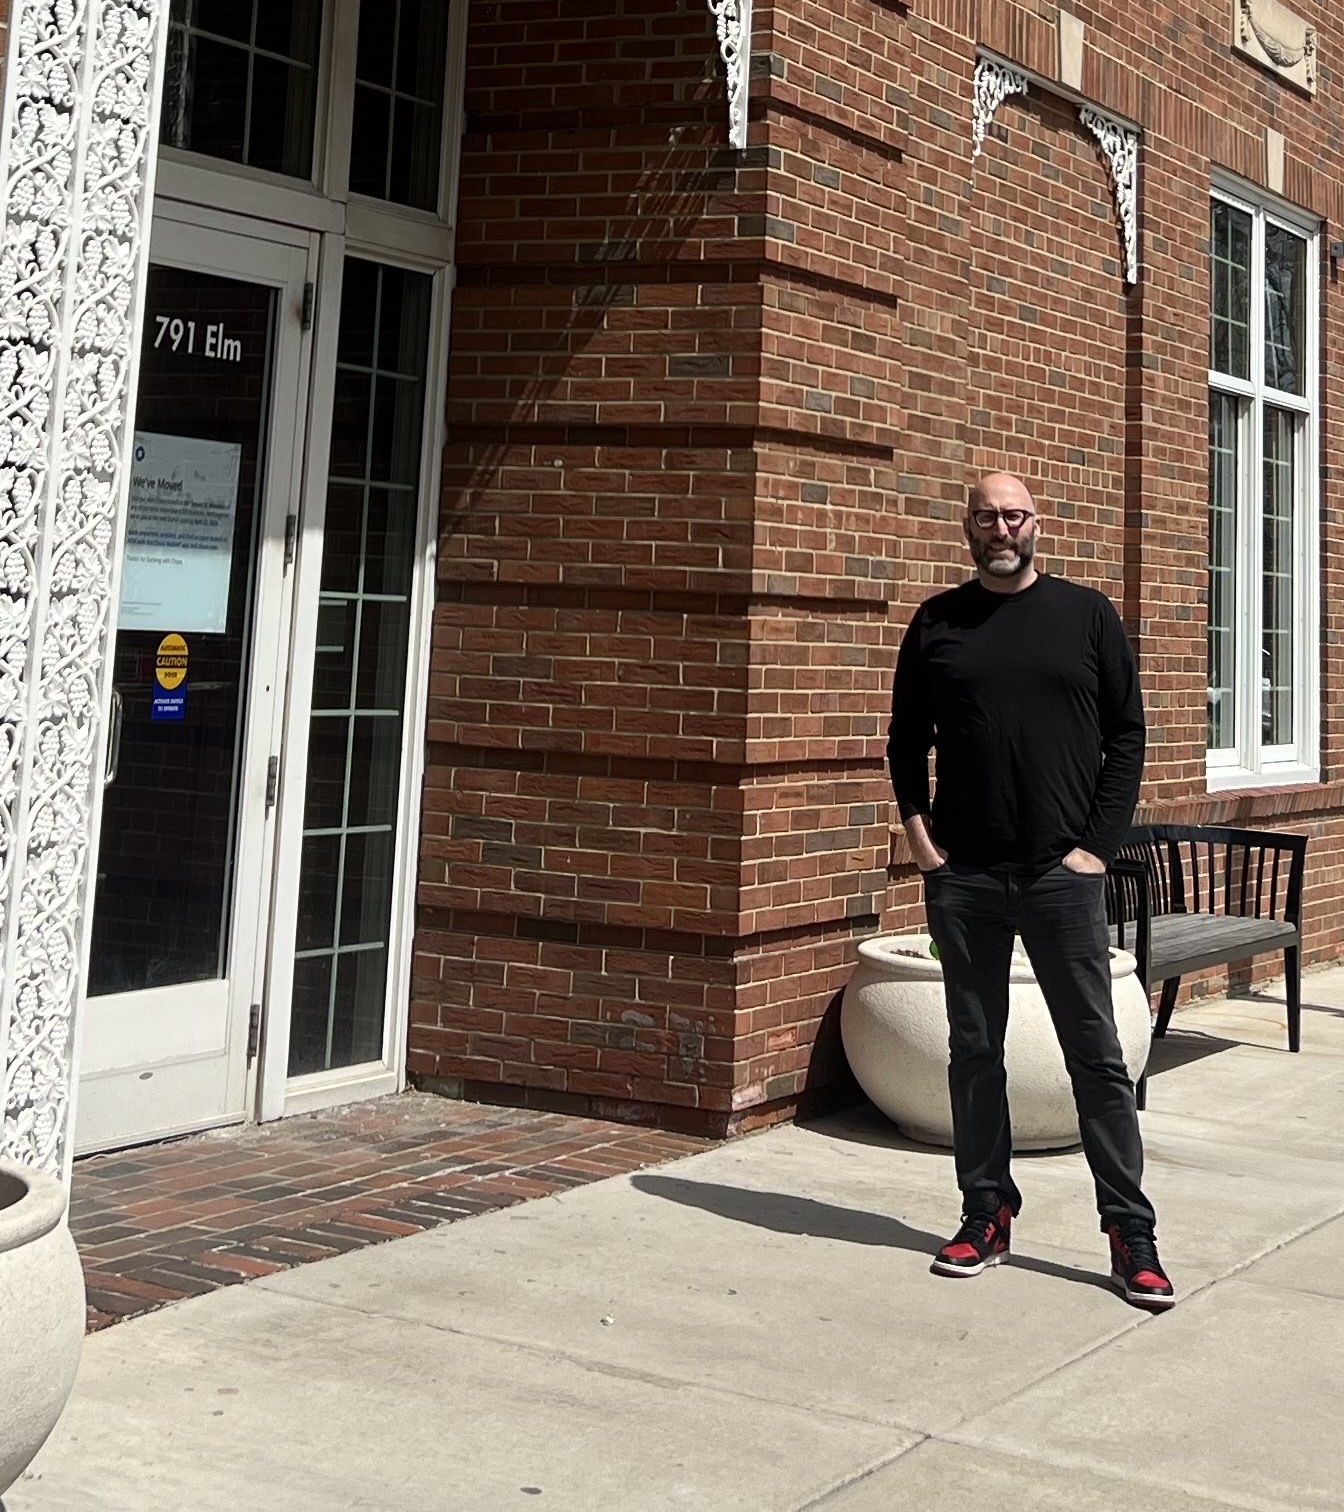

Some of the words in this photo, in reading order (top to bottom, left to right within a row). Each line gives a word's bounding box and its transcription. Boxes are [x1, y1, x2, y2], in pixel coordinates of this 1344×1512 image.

[153, 315, 196, 354] 791
[204, 322, 242, 362] Elm
[157, 478, 184, 491] Moved
[156, 656, 187, 667] CAUTION
